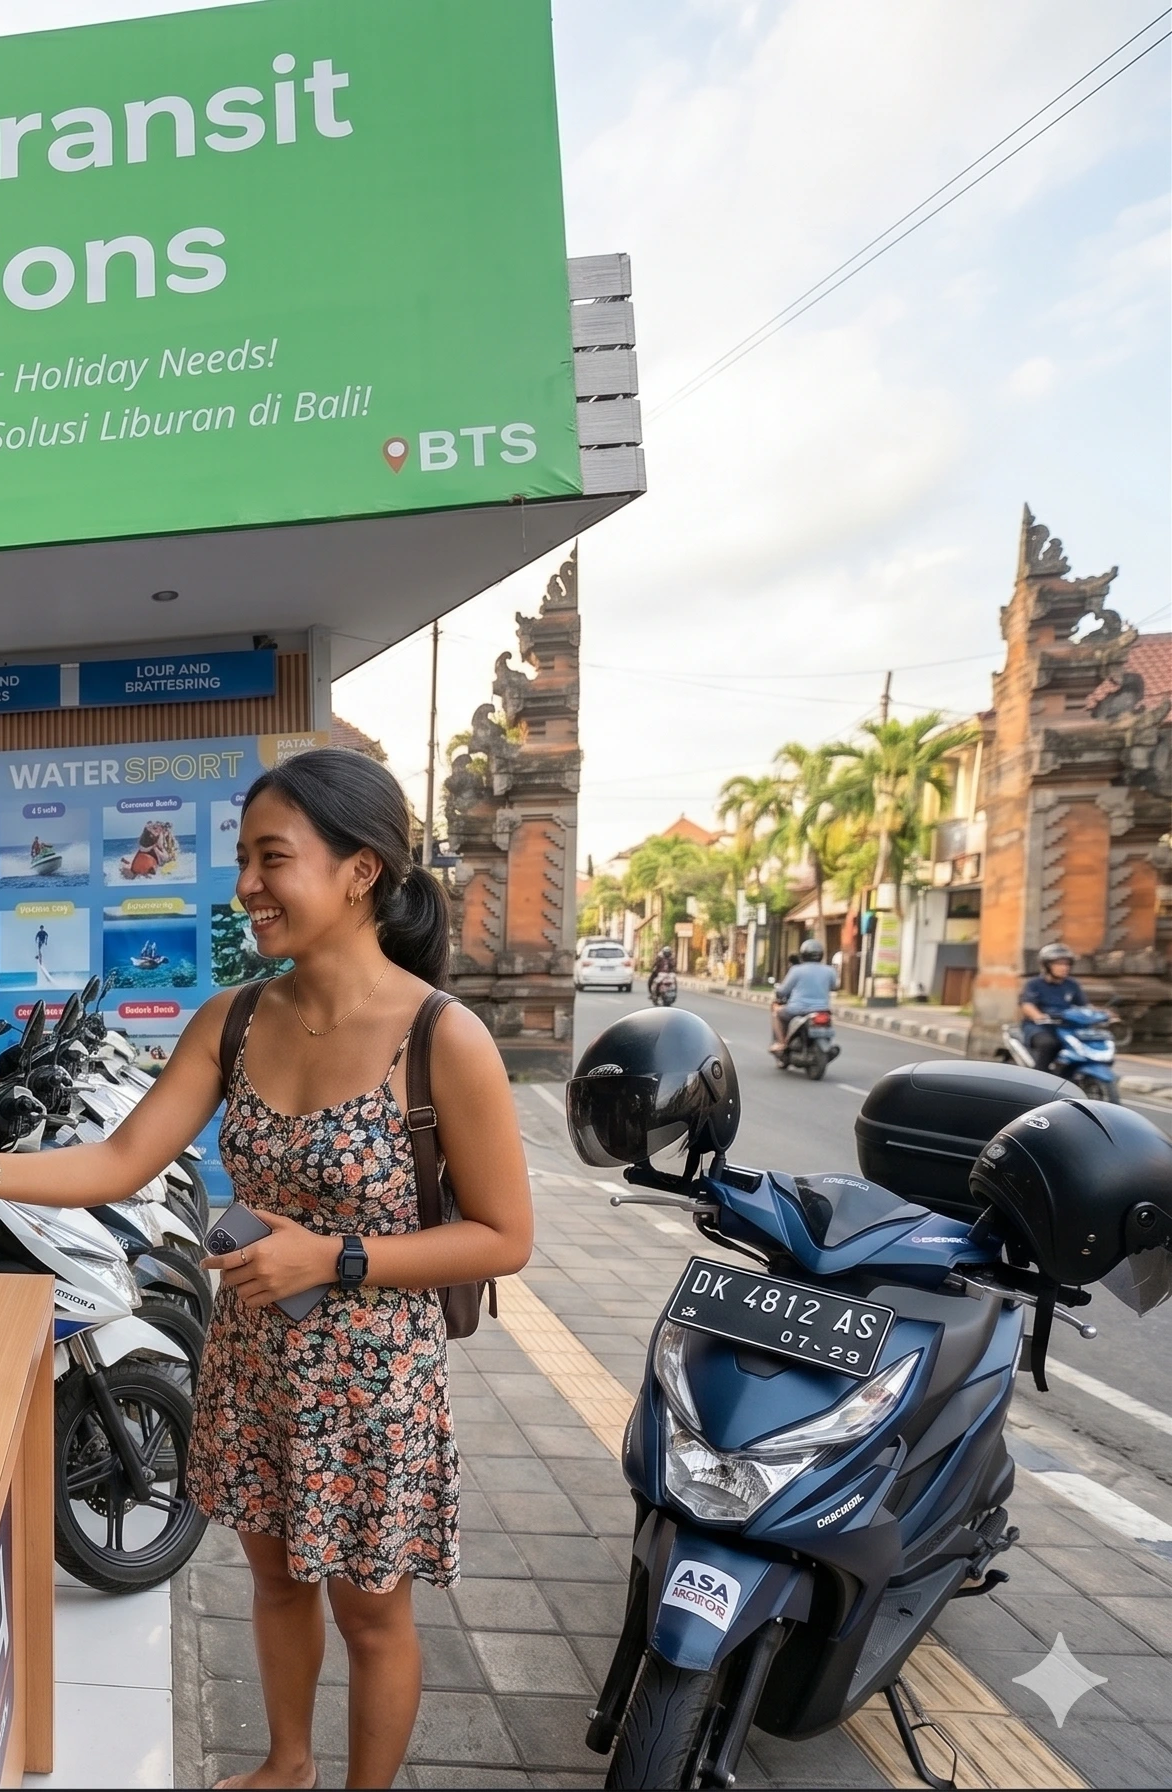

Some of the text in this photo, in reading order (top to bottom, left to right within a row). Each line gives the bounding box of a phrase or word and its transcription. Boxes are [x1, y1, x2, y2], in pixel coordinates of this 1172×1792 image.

[14, 353, 149, 393] Holiday
[158, 337, 279, 379] Needs!
[99, 403, 236, 443] Liburan
[248, 393, 283, 427] di
[293, 385, 373, 424] Bali!
[418, 422, 538, 472] BTS
[136, 663, 211, 678] LOUR AND
[9, 751, 245, 790] WATER SPORT
[691, 1269, 877, 1339] DK 4812 AS
[676, 1569, 729, 1605] ASA
